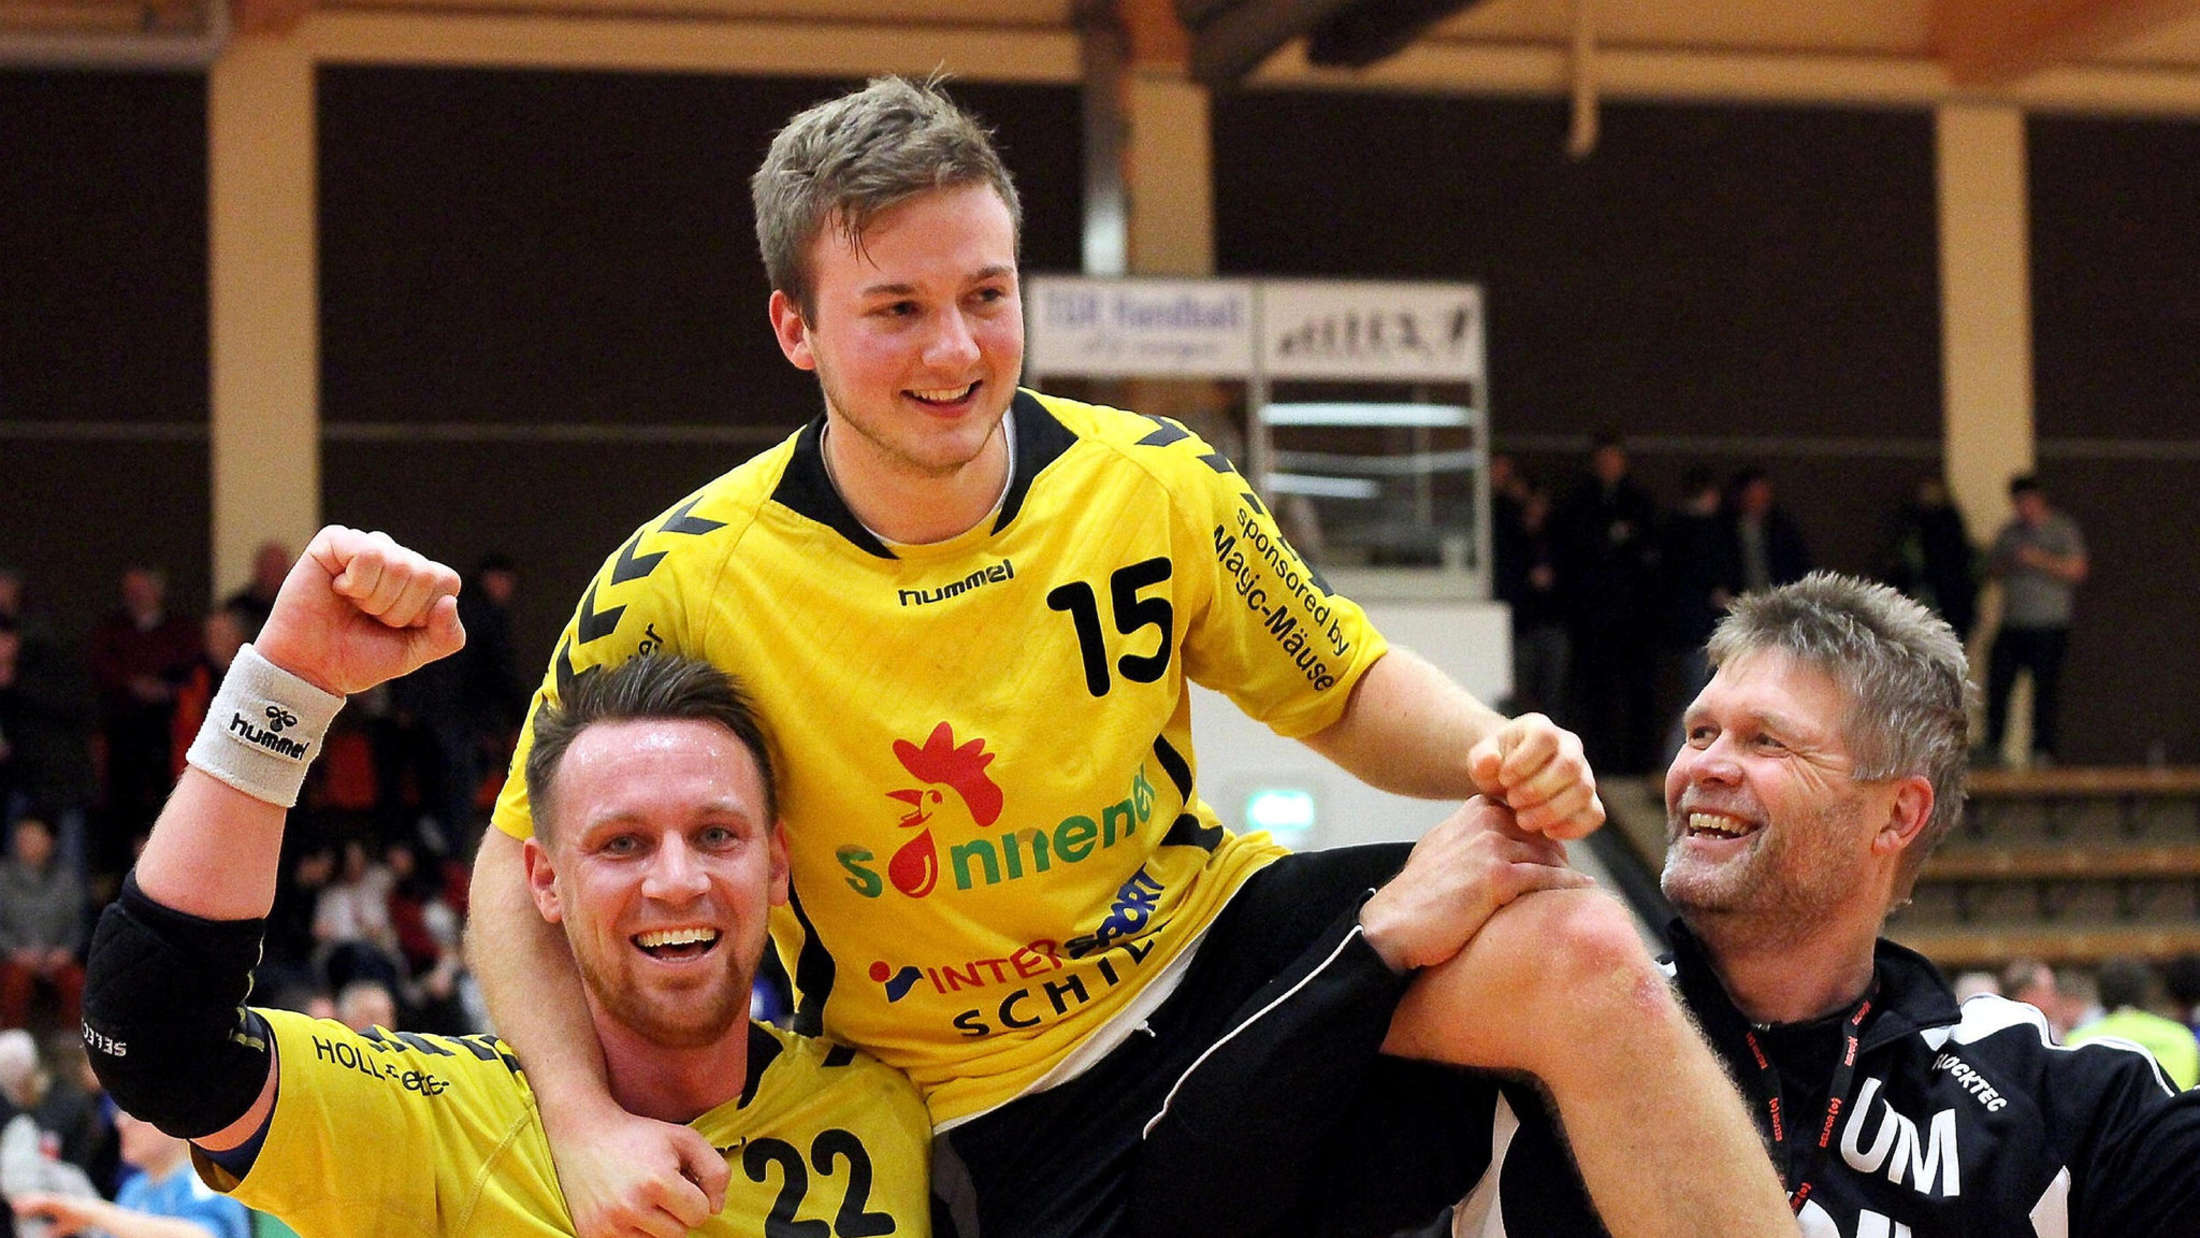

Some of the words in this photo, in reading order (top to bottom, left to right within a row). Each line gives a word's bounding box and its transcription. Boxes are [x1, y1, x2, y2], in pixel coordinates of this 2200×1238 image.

[898, 559, 1014, 606] hummel
[1046, 556, 1172, 697] 15
[1237, 508, 1330, 626] sponsored
[1327, 619, 1349, 656] by
[230, 712, 310, 760] hummel
[743, 1128, 896, 1238] 22
